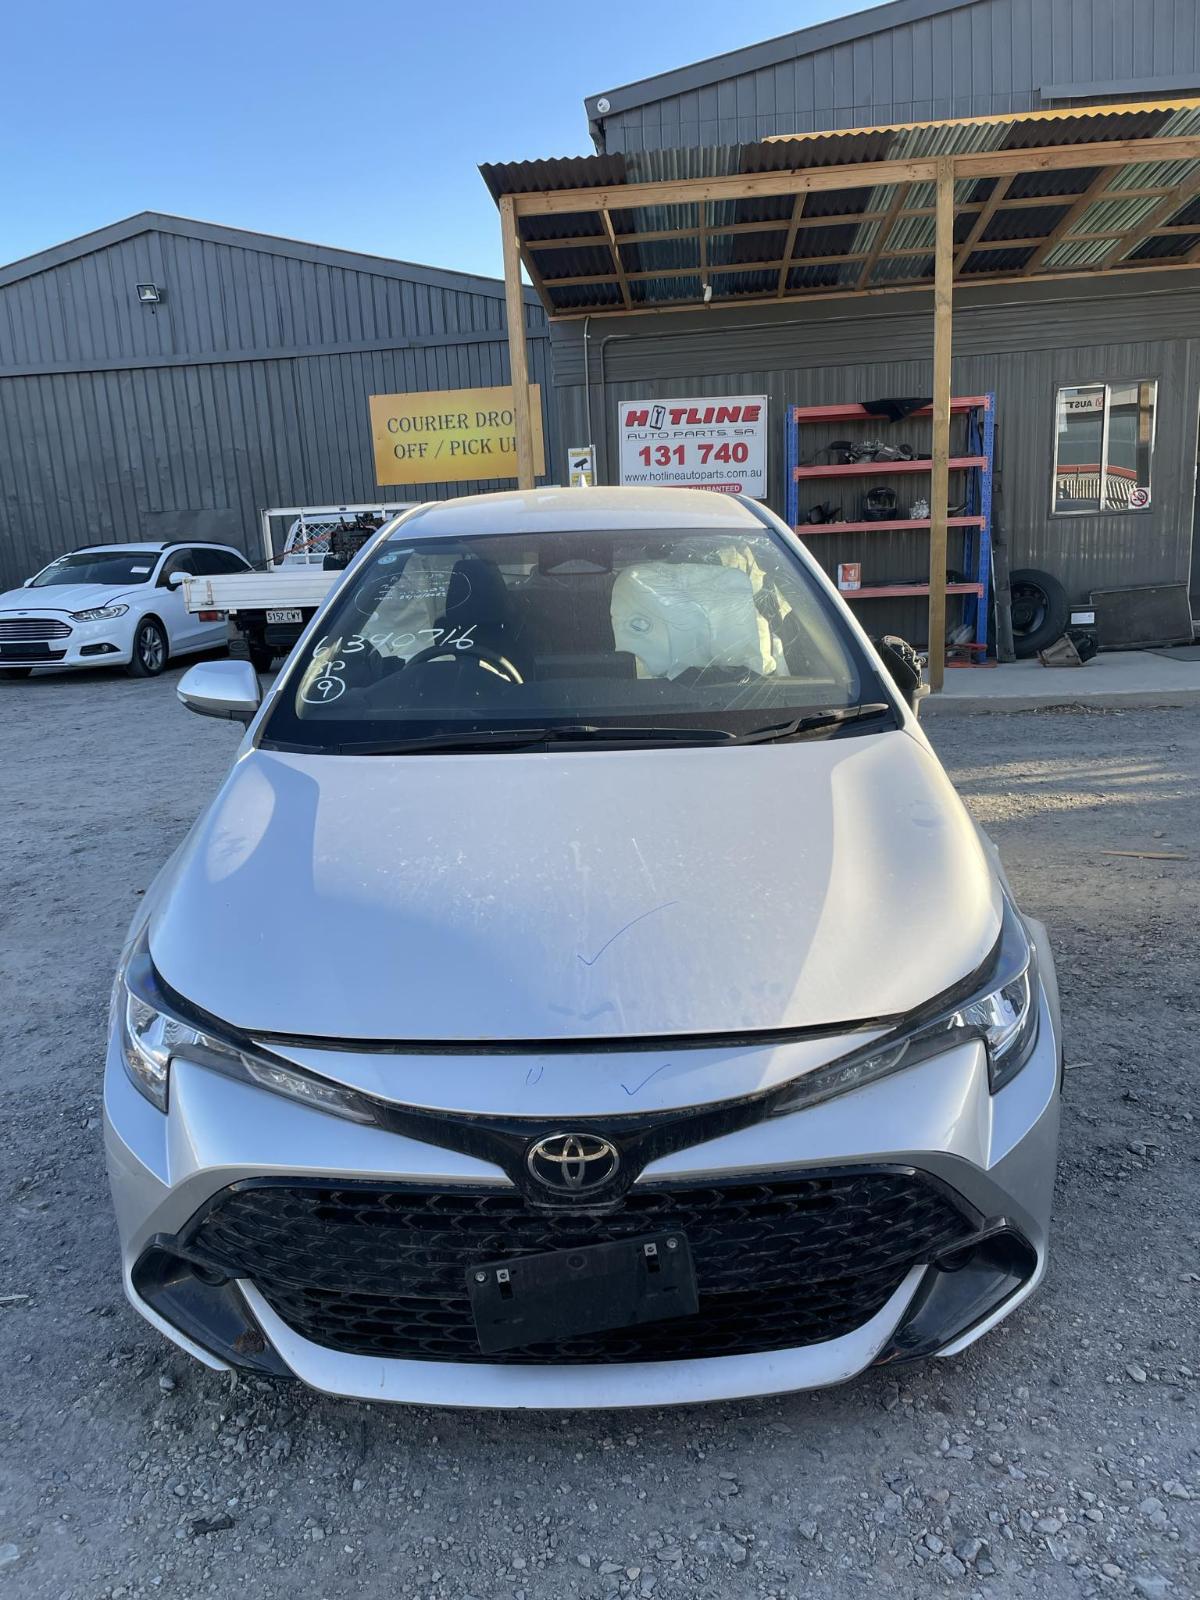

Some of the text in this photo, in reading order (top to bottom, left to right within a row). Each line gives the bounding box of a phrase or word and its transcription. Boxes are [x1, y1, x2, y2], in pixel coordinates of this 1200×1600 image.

[387, 408, 517, 433] COURIER DRO
[627, 432, 669, 440] AUTO
[393, 442, 428, 459] OFF
[434, 440, 444, 458] /
[450, 438, 492, 456] PICK
[638, 442, 749, 467] 131 740
[624, 469, 762, 482] www.hotlineautoparts.com.au
[267, 612, 285, 621] S152
[317, 680, 334, 698] 9
